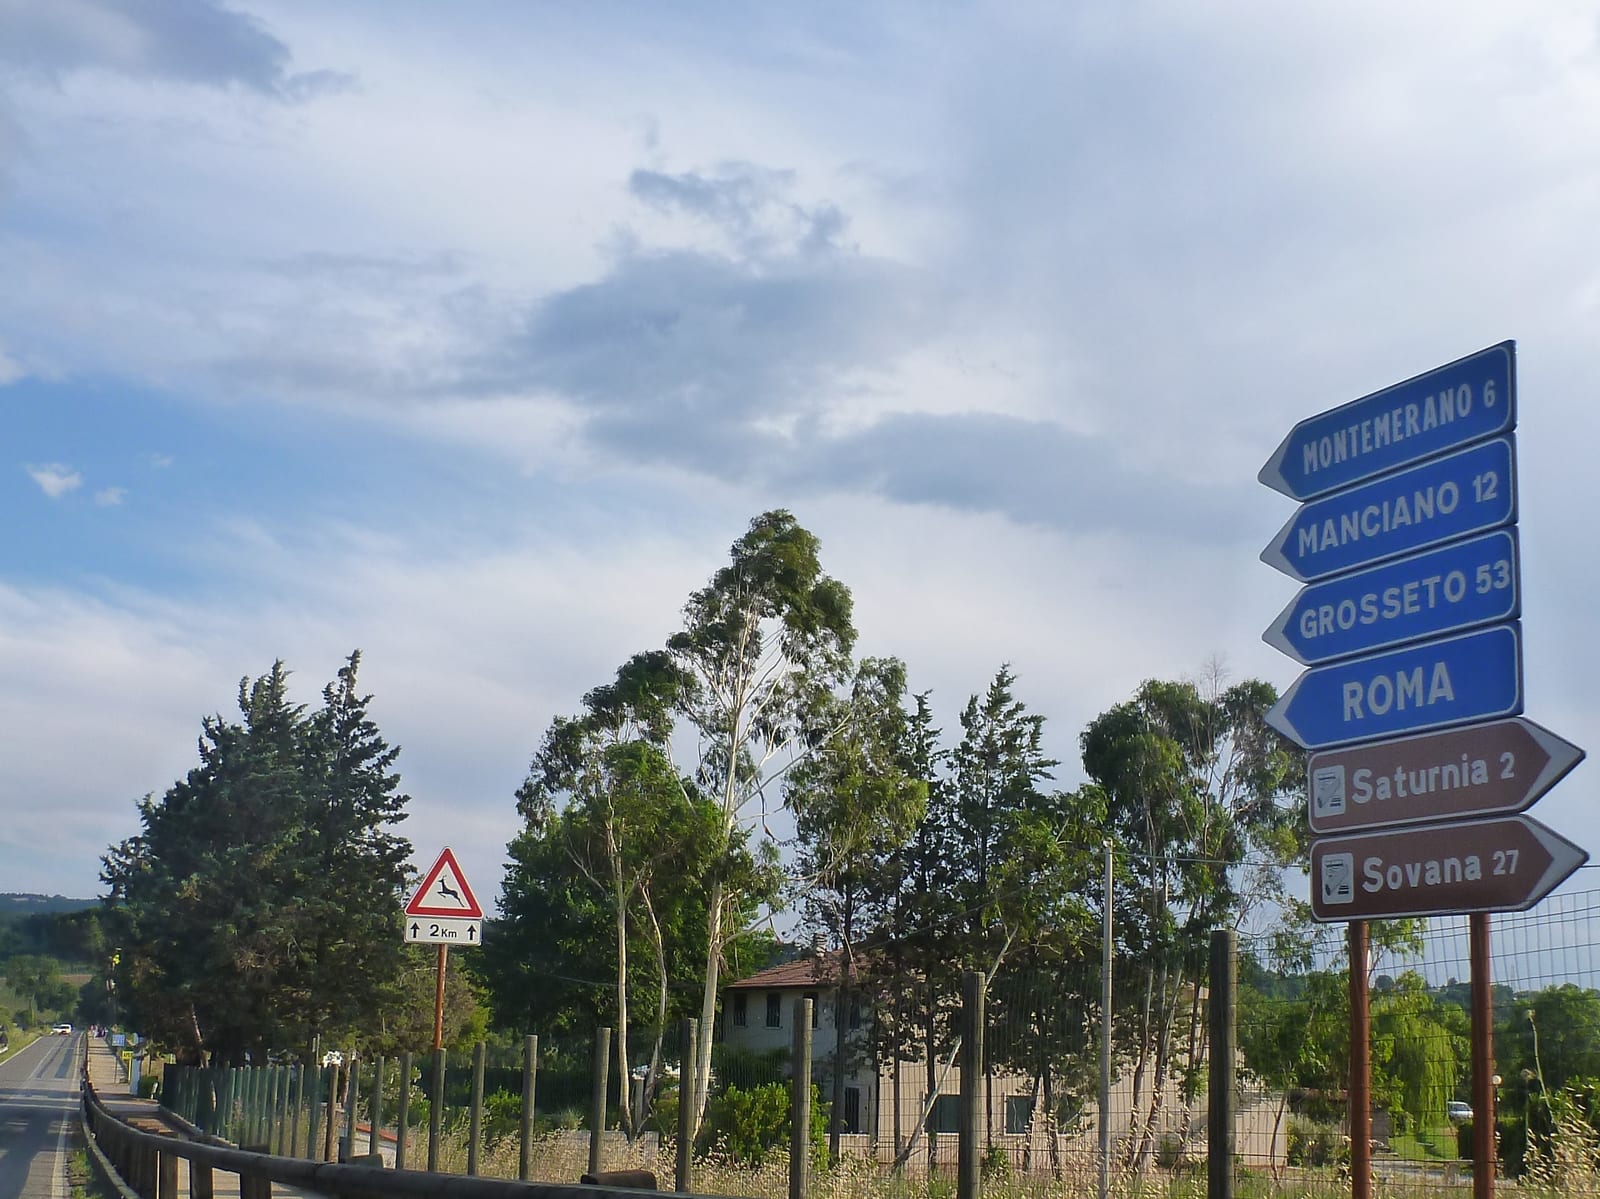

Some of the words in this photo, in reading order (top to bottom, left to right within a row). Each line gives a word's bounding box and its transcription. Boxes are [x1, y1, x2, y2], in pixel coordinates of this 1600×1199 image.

[1303, 384, 1472, 474] MONTEMERANO
[1483, 379, 1496, 408] 6
[1299, 482, 1458, 557] MANCIANO
[1473, 471, 1498, 502] 12
[1300, 571, 1466, 639] GROSSETO
[1475, 560, 1510, 594] 53
[1343, 662, 1454, 721] ROMA
[1352, 754, 1488, 804] Saturnia
[1500, 752, 1515, 779] 2
[1362, 855, 1482, 893] Sovana
[1492, 850, 1519, 875] 27
[429, 924, 440, 937] 2
[441, 928, 457, 938] Km
